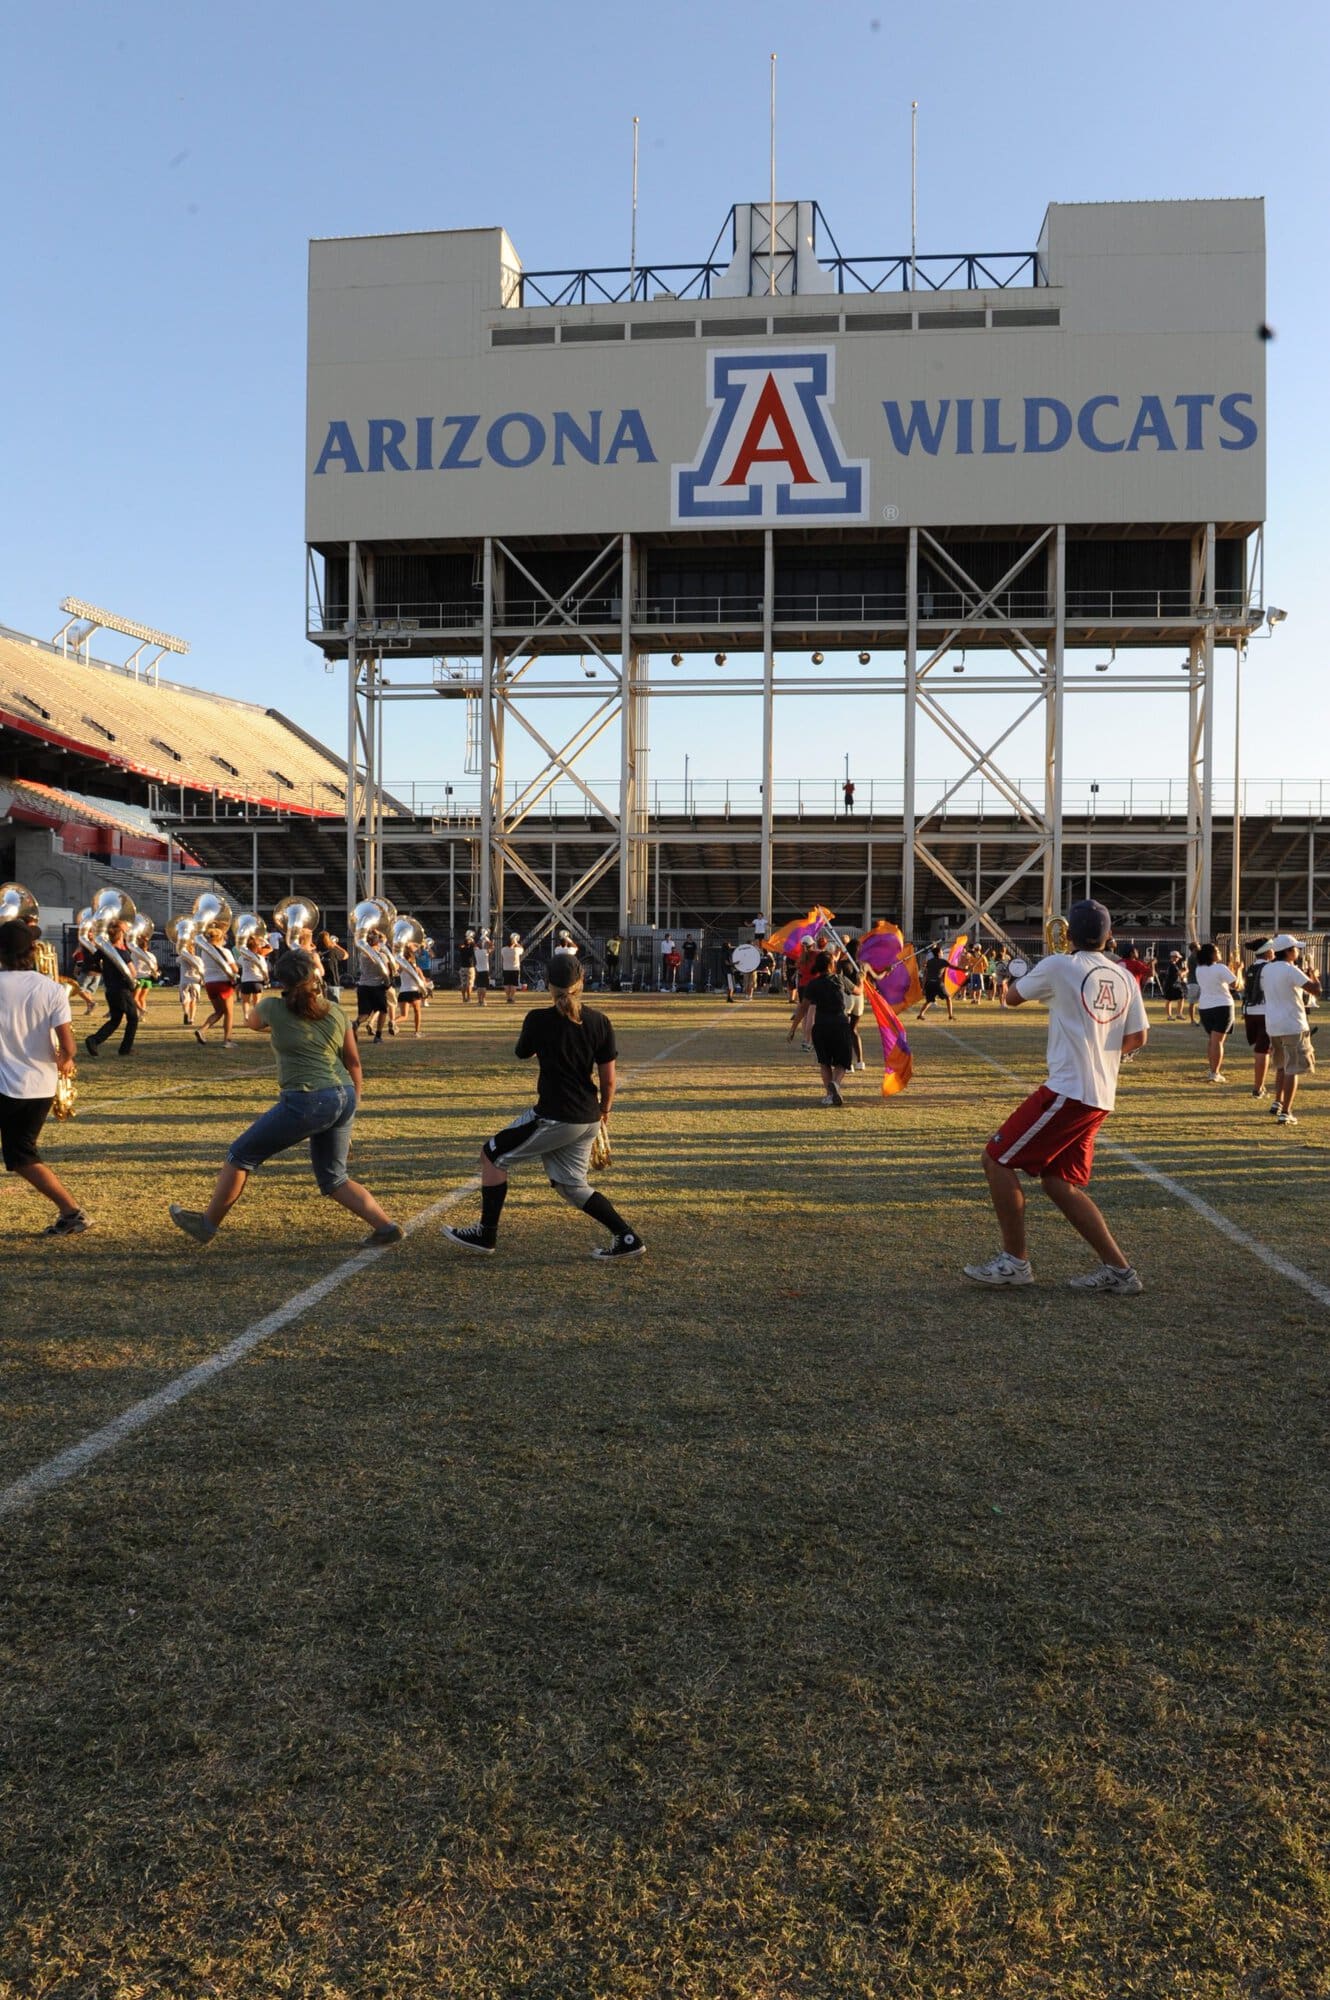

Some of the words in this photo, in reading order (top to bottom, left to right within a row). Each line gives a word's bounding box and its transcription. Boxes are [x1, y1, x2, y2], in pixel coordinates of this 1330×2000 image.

[313, 409, 659, 474] ARIZONA
[675, 349, 866, 522] A
[881, 392, 1258, 456] WILDCATS
[1093, 979, 1117, 1011] A
